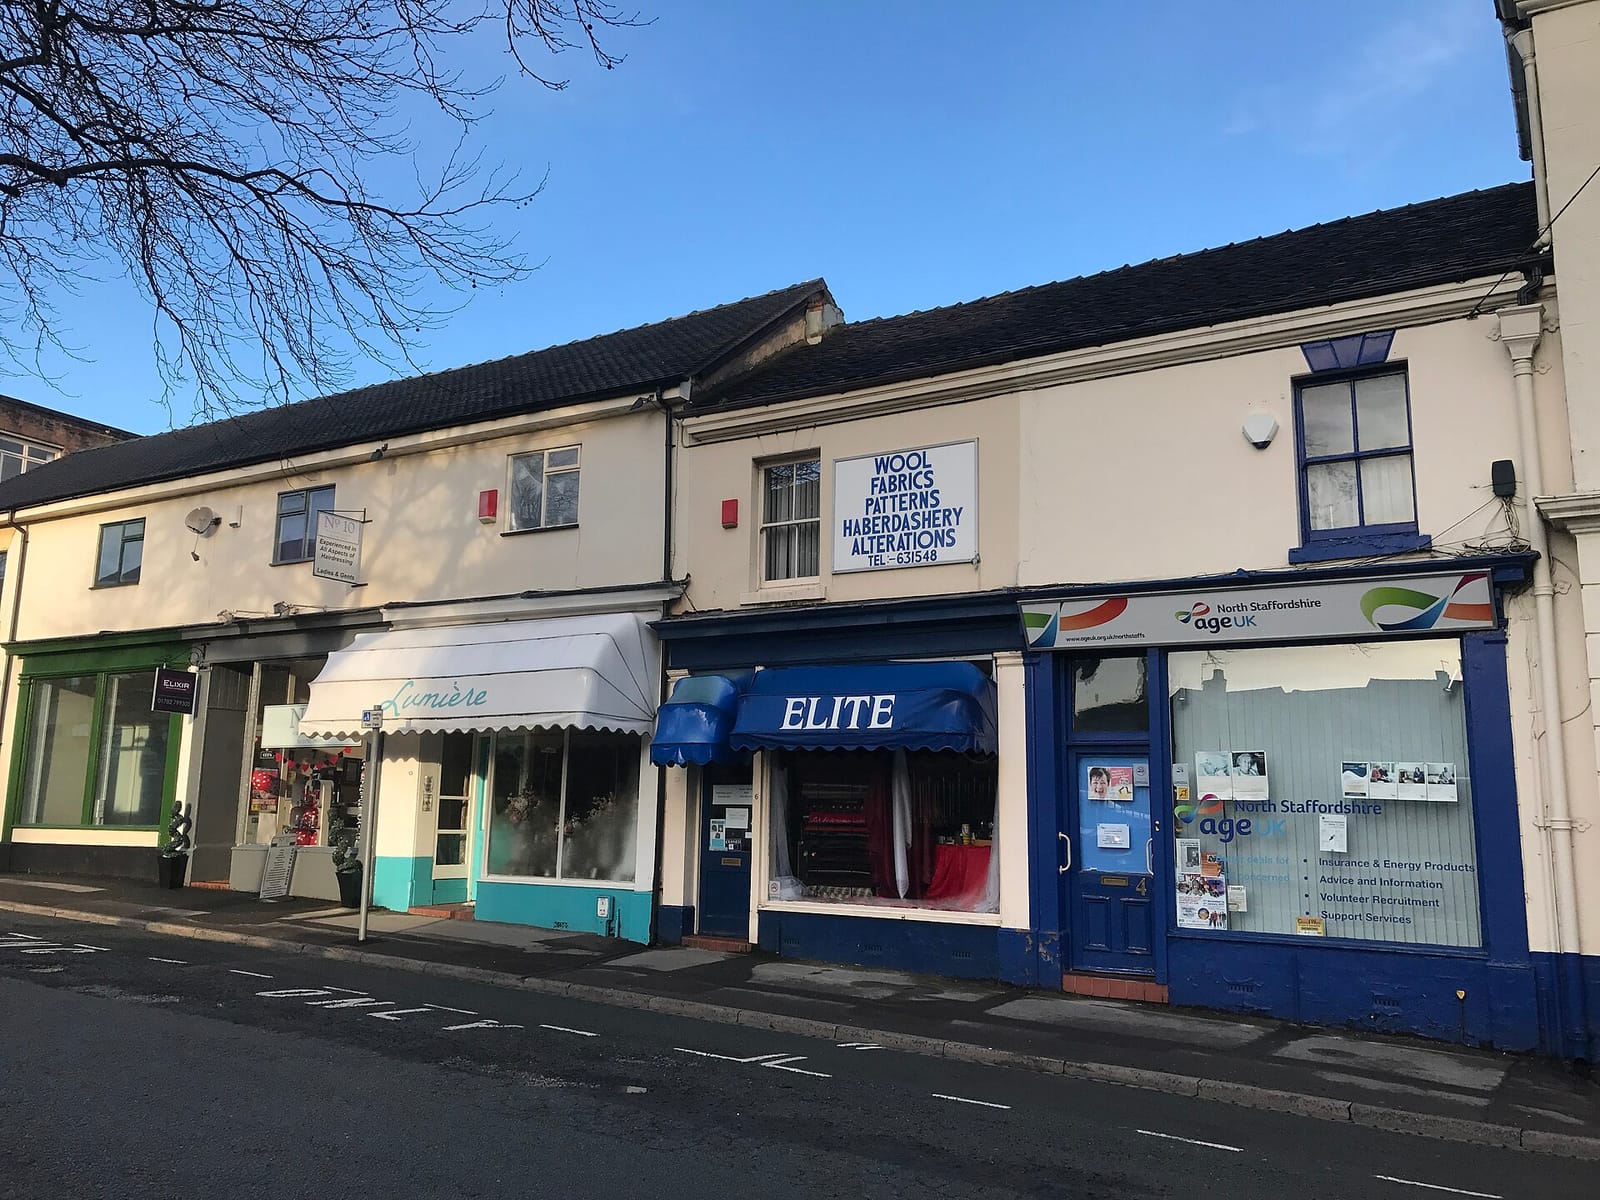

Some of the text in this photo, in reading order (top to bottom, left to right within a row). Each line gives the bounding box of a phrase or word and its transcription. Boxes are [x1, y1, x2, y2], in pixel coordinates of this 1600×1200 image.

[874, 451, 932, 475] WOOL
[871, 470, 934, 495] FABRICS
[865, 489, 940, 515] PATTERNS
[343, 521, 355, 533] 10
[843, 507, 963, 537] HABERDASHERY
[320, 538, 350, 552] Experienced
[851, 528, 956, 556] ALTERATIONS
[321, 553, 353, 566] Hairdressing
[328, 547, 348, 558] Aspects
[317, 567, 333, 577] Ladies
[340, 572, 355, 580] Gents
[1216, 599, 1322, 613] North Staffordshire
[380, 680, 488, 717] Lumière
[778, 694, 896, 730] ELITE
[1234, 799, 1382, 815] North Staffordshire
[1319, 857, 1475, 873] Insurance & Energy Products
[1136, 877, 1147, 896] 4
[1319, 875, 1443, 889] Advice and Information
[1320, 892, 1440, 907] Volunteer Recruitment
[1320, 910, 1412, 924] Support Services
